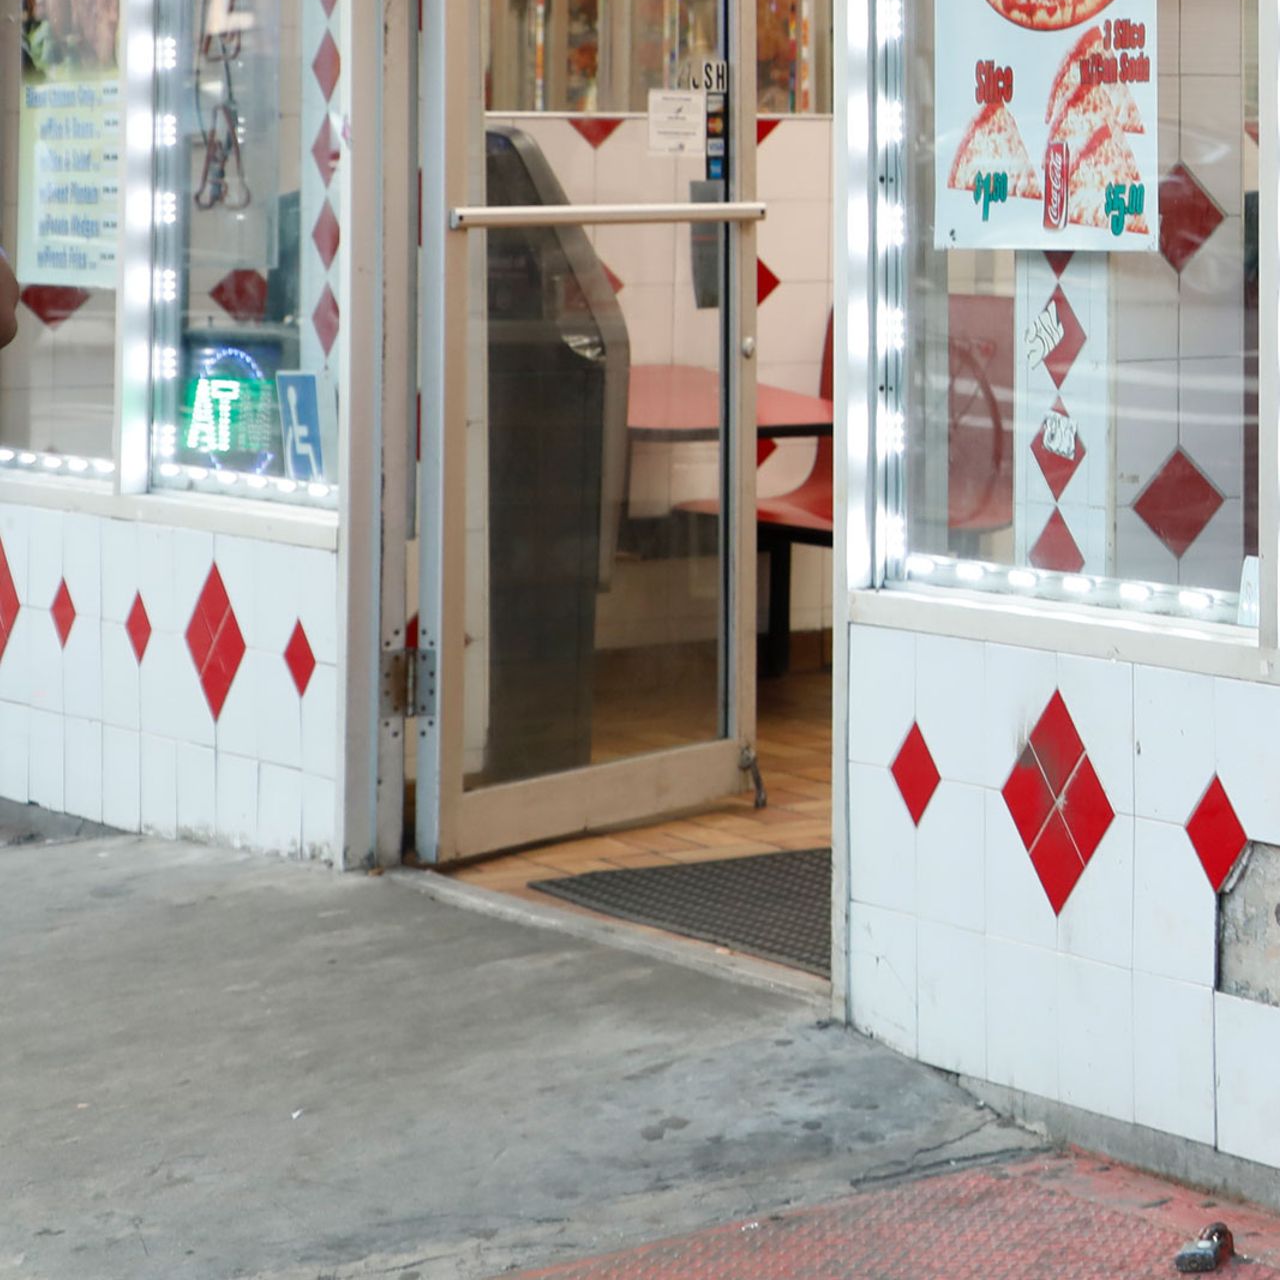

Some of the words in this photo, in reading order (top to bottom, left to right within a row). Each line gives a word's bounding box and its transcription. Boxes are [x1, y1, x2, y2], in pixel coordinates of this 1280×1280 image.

[1114, 18, 1146, 50] Slice
[975, 59, 1014, 104] Slice
[1119, 51, 1151, 83] Soda
[1104, 182, 1145, 237] $5.00
